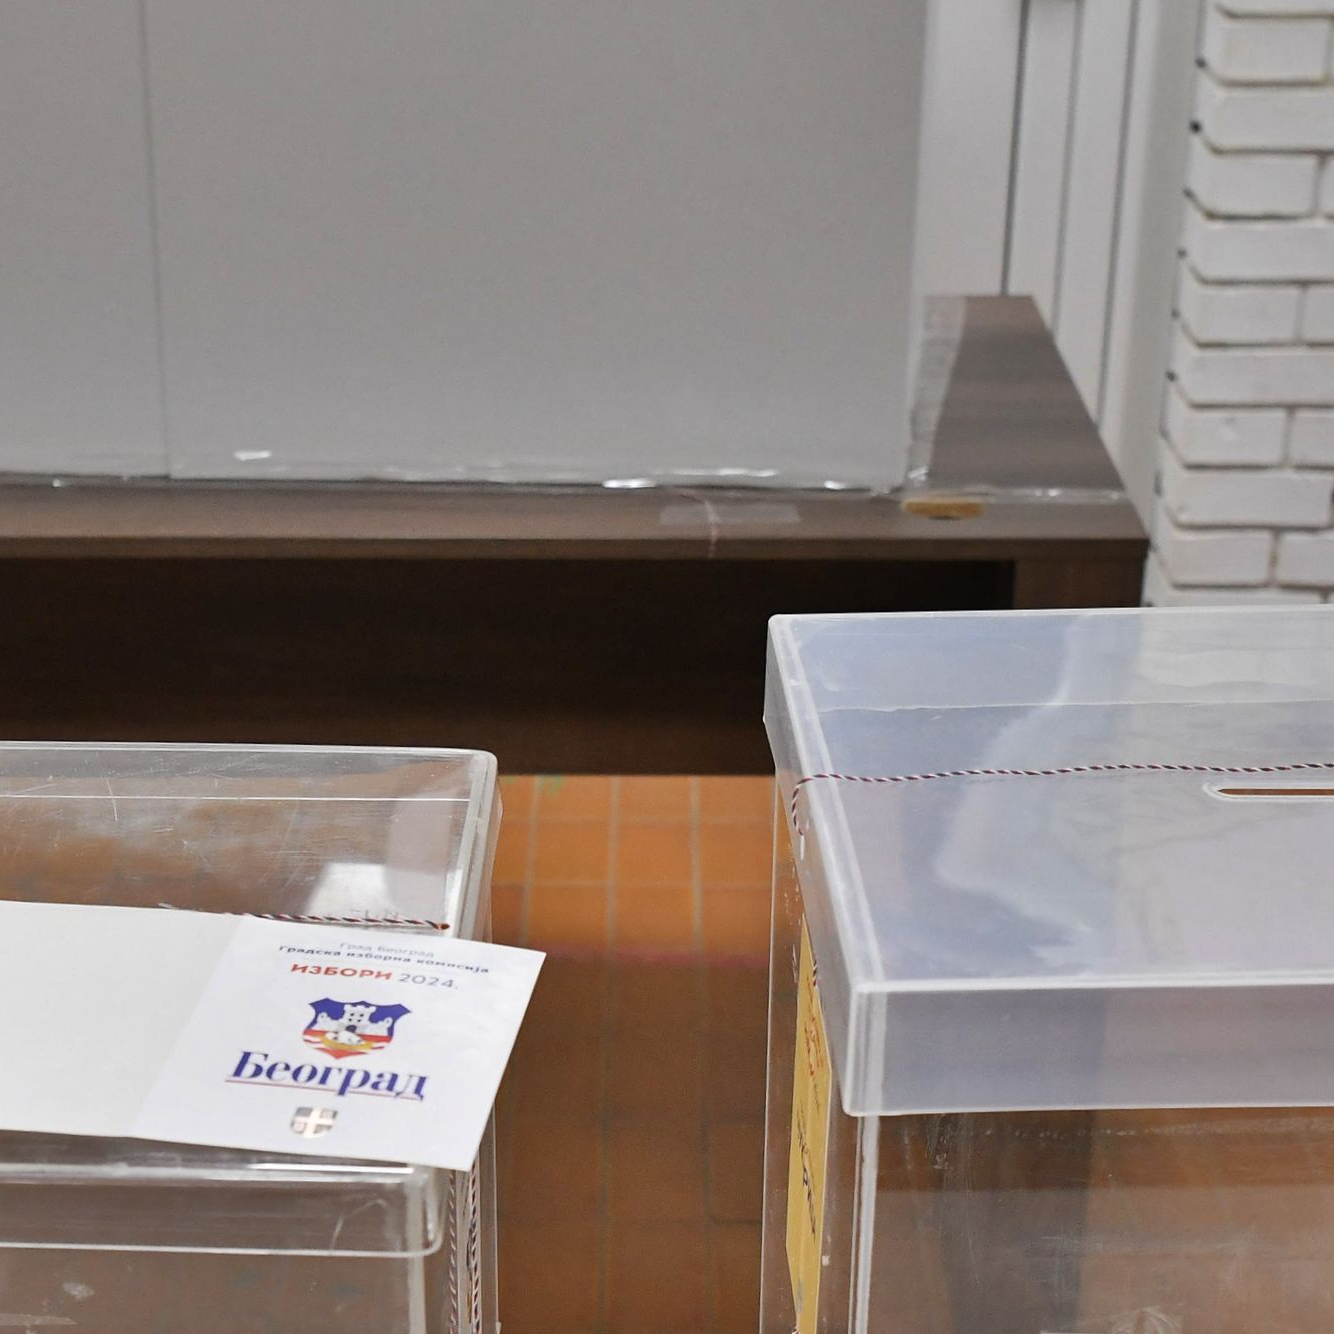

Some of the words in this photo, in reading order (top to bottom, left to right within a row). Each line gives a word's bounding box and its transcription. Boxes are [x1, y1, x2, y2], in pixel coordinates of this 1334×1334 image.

[290, 963, 393, 981] ИЗБОРИ
[398, 973, 459, 990] 2024.
[229, 1050, 429, 1101] Београд
